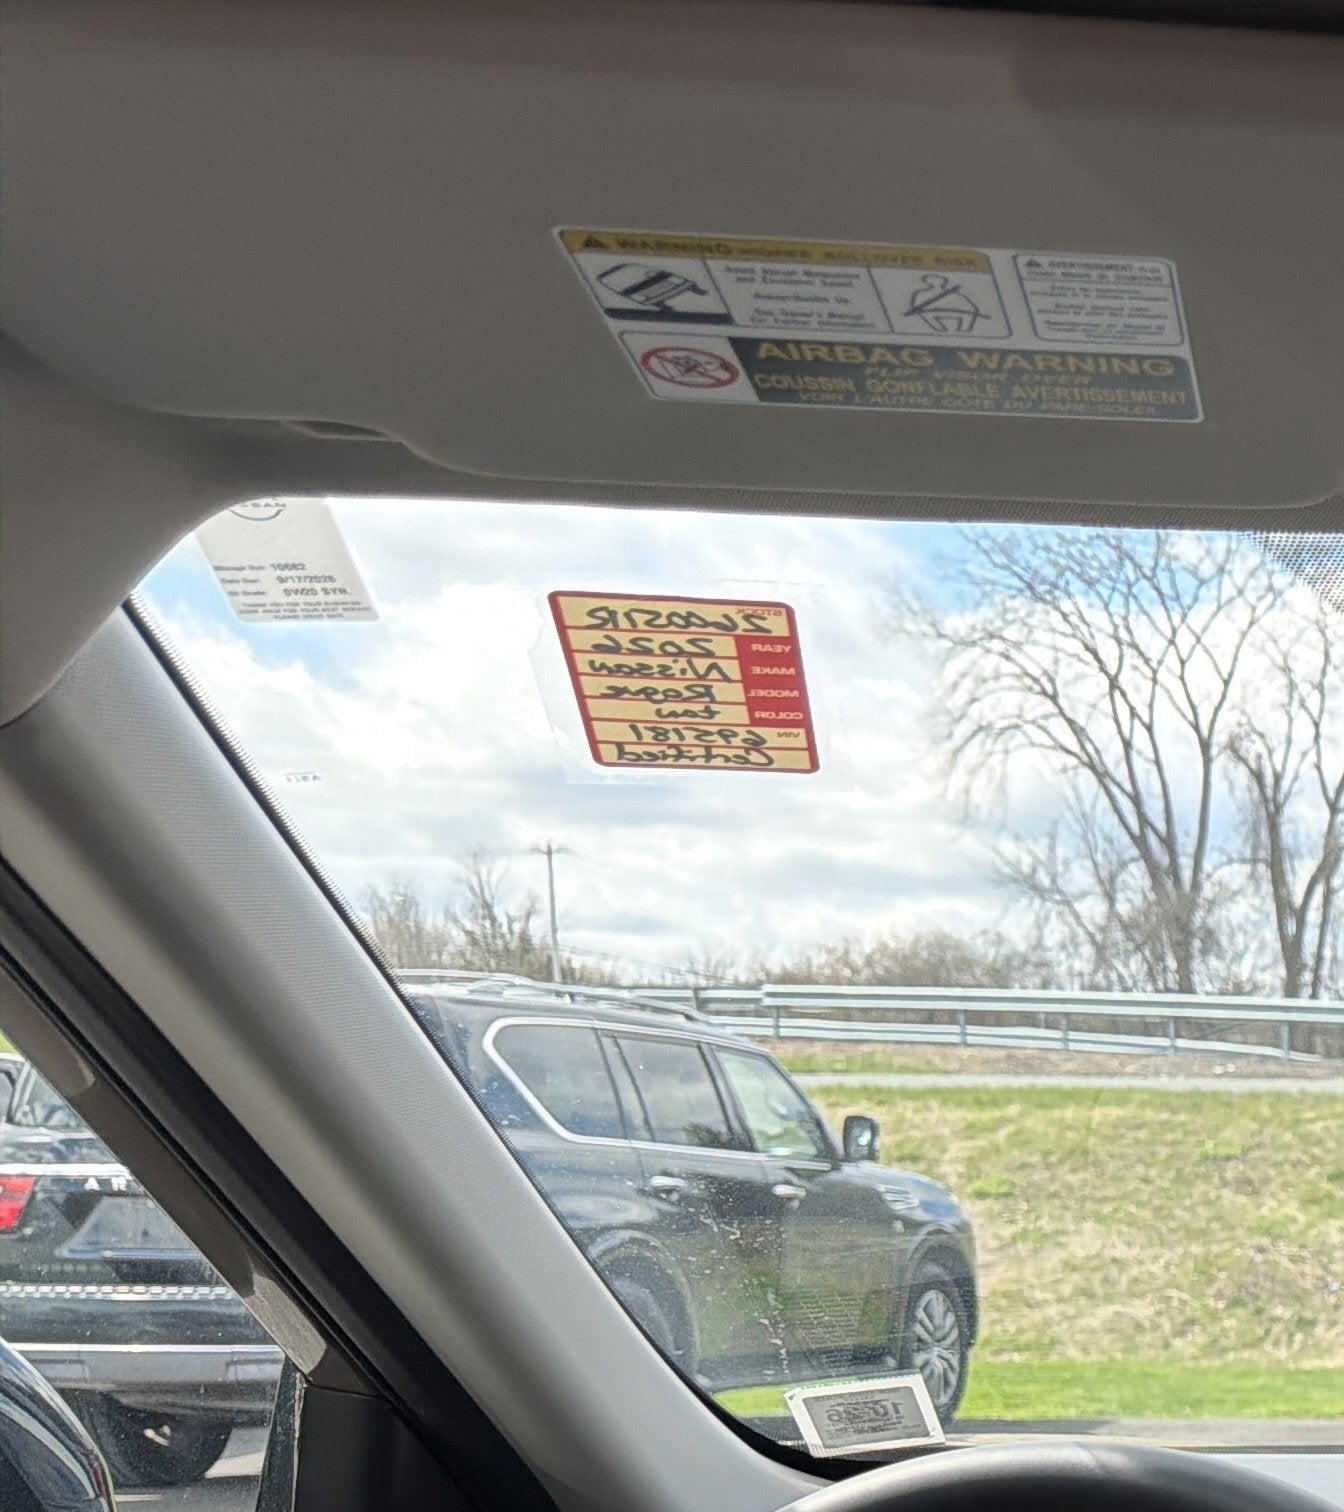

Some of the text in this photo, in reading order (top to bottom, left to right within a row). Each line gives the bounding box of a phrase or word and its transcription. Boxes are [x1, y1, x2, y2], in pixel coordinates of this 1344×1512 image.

[757, 341, 1176, 376] AIRBAG WARNING
[754, 373, 1188, 406] COUSSIN GONFLABLE AVERTISSEMENT
